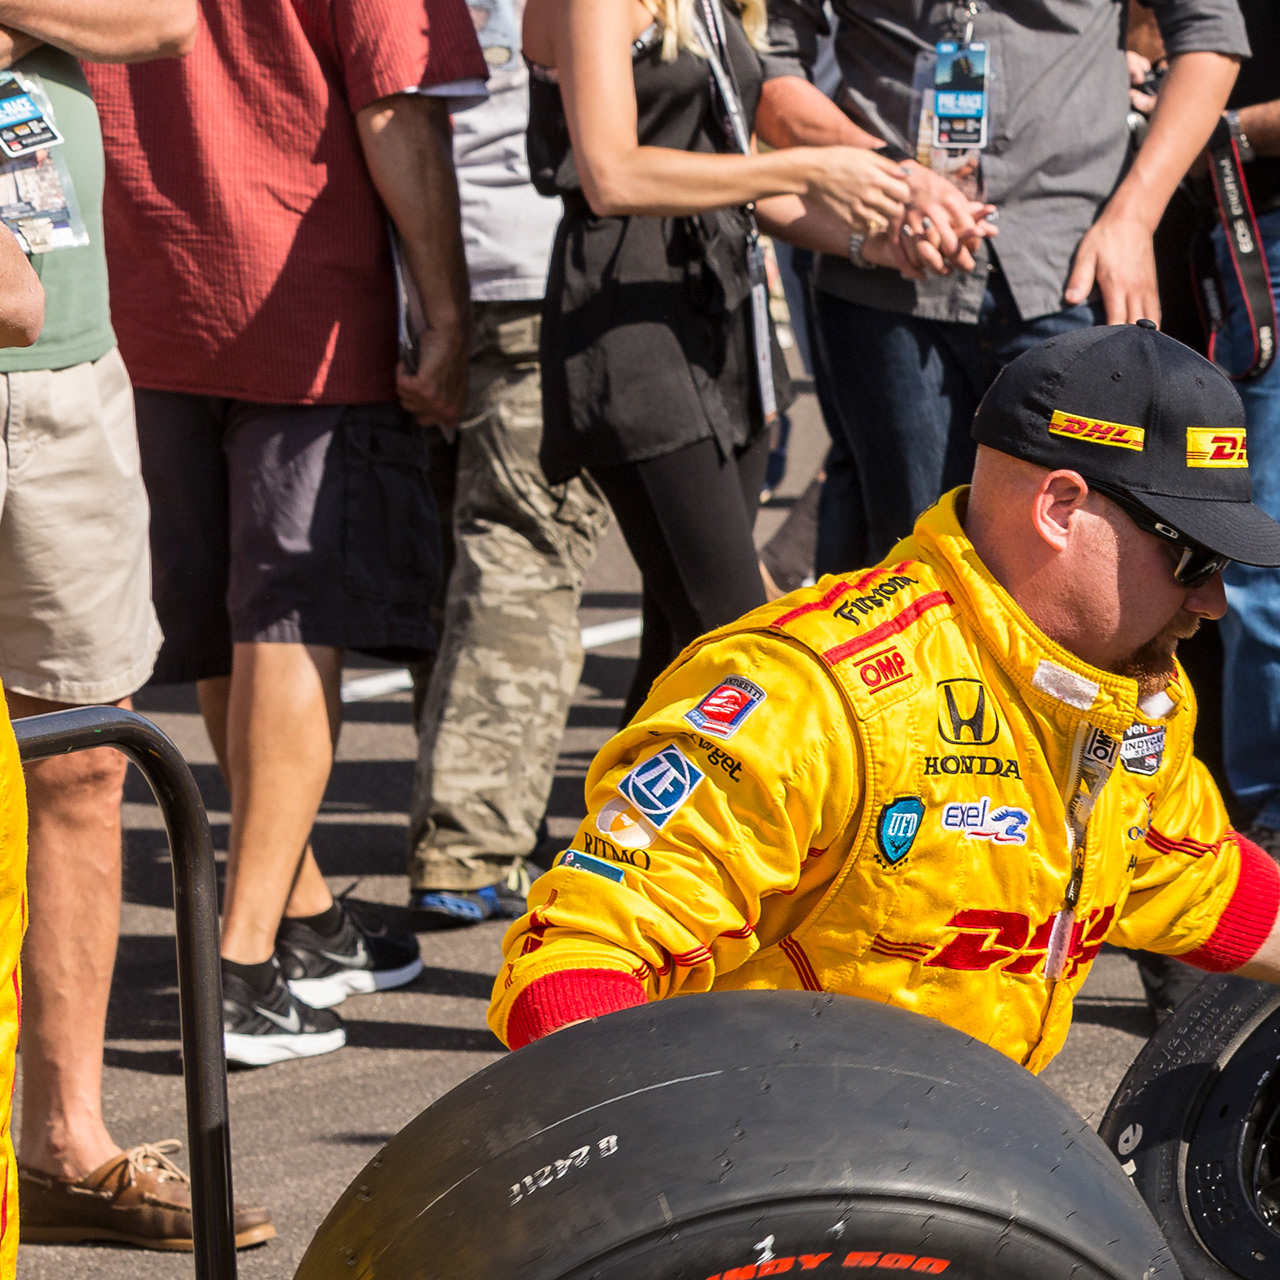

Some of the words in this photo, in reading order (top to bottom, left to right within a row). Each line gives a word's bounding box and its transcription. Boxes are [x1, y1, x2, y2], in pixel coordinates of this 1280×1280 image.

[1060, 417, 1131, 443] DHL
[860, 651, 906, 688] OMP
[924, 755, 1023, 780] HONDA
[888, 812, 918, 838] UFD
[841, 1250, 952, 1275] 500
